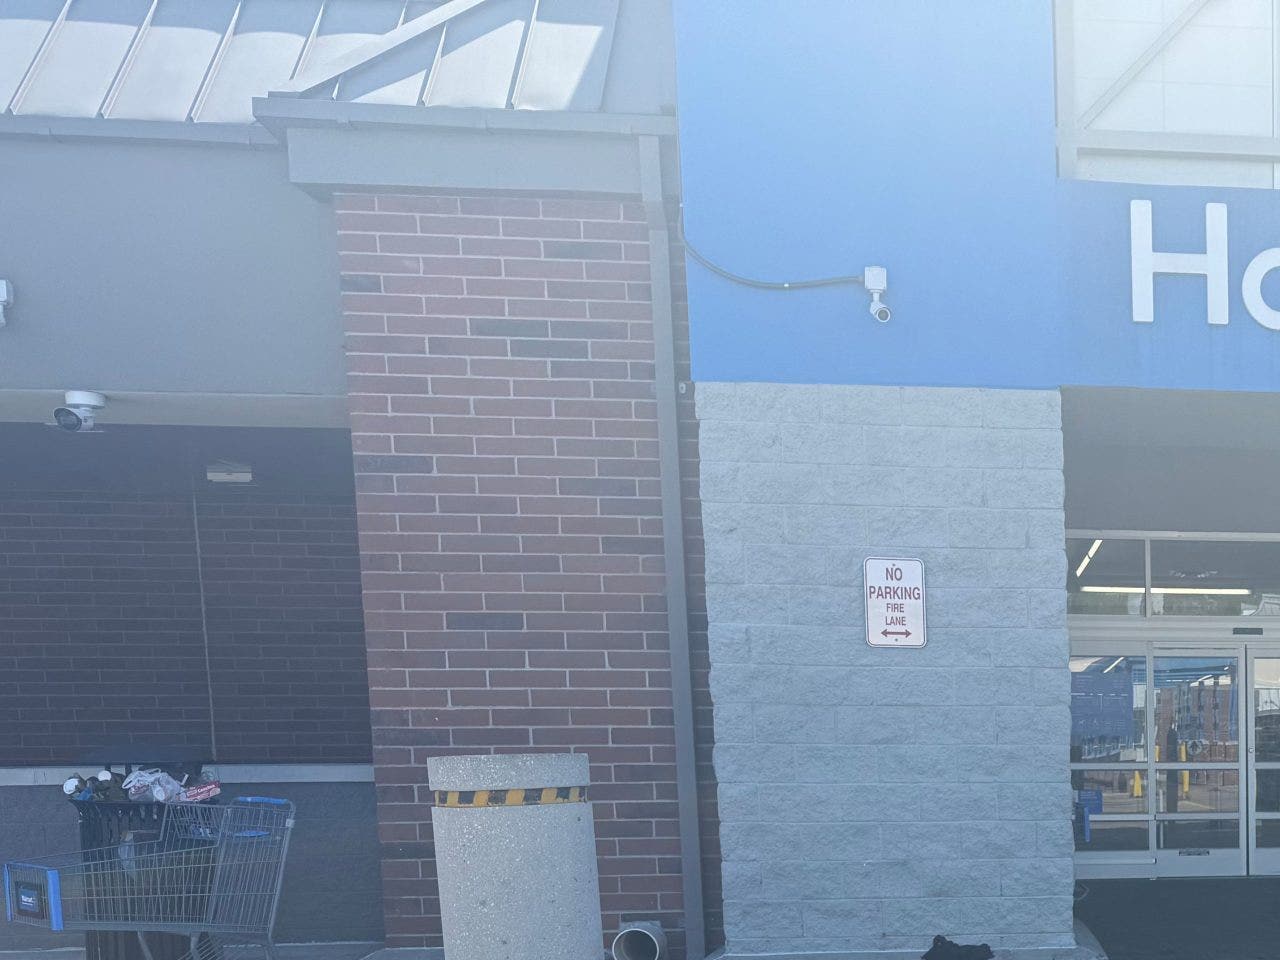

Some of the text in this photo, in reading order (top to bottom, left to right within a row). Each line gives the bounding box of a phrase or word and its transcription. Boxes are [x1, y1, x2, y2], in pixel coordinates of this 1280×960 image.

[885, 567, 903, 581] NO
[869, 585, 921, 600] PARKING
[886, 602, 905, 613] FIRE
[885, 615, 907, 626] LANE
